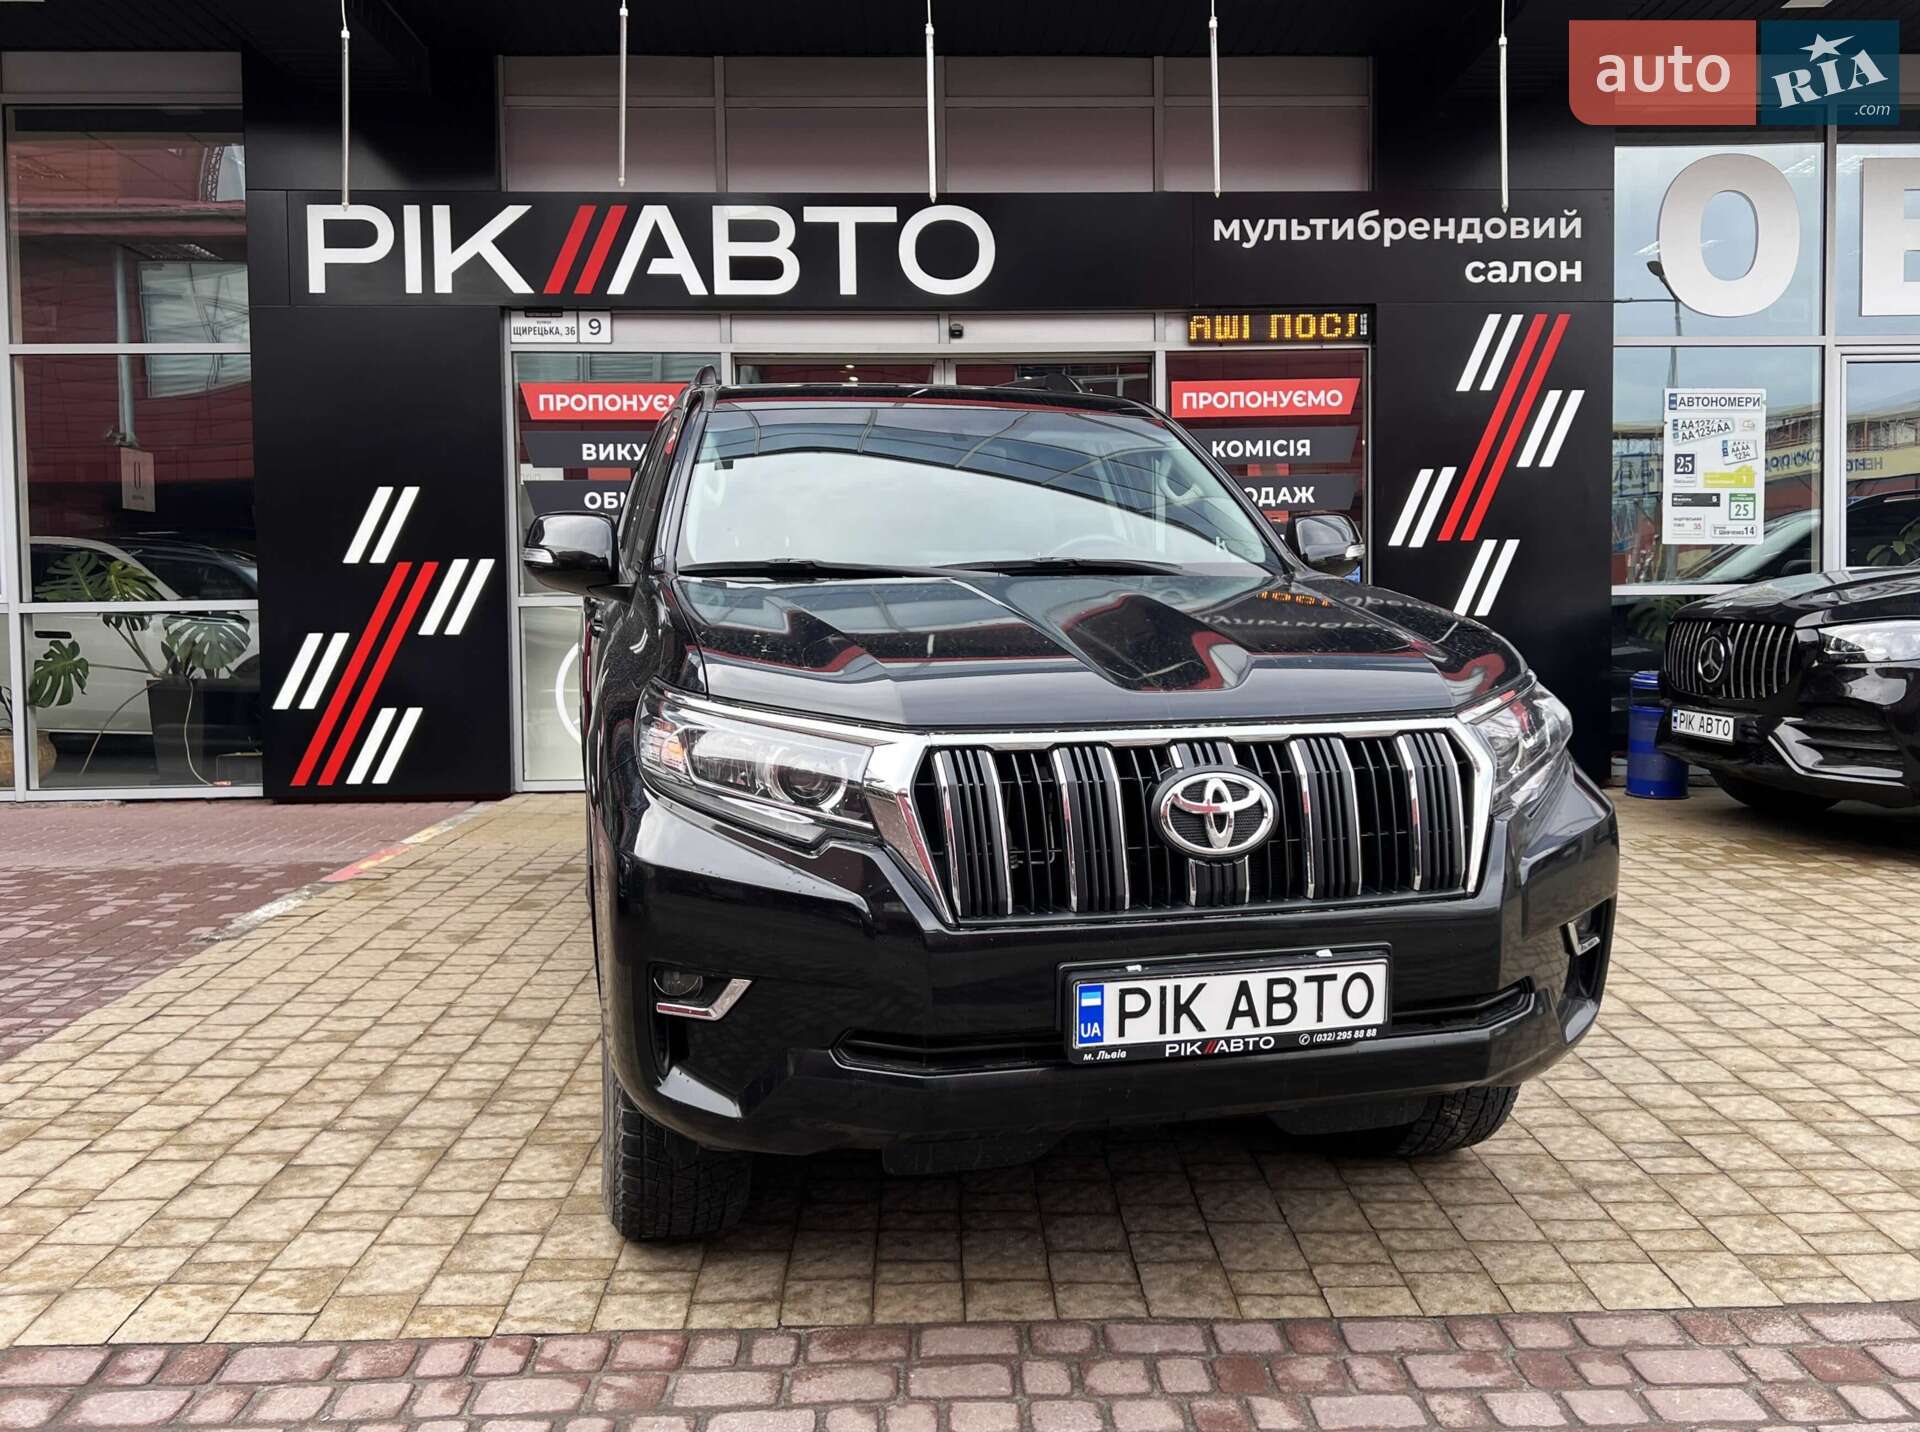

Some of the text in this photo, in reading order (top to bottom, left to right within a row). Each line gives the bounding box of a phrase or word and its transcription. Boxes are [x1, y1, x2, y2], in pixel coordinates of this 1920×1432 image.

[1212, 208, 1583, 249] мультибрендовий
[1464, 259, 1583, 284] салон
[564, 326, 576, 336] 36
[588, 318, 602, 336] 9
[1181, 389, 1344, 410] ПРОПОНУЄМО
[1678, 396, 1760, 408] АВТОНОМЕРИ
[581, 442, 648, 461] ВИКУ
[1211, 438, 1312, 458] КОМІСІЯ
[1676, 456, 1693, 474] 25
[1243, 485, 1316, 507] ОДАЖ
[1734, 503, 1749, 517] 25
[1744, 526, 1755, 535] 14
[1679, 712, 1731, 737] РІК АВТО
[1117, 971, 1375, 1038] РІК АВТО
[1081, 1023, 1101, 1038] UA
[1312, 1031, 1336, 1043] (032)
[1336, 1030, 1353, 1041] 295
[1098, 1050, 1127, 1061] Львів
